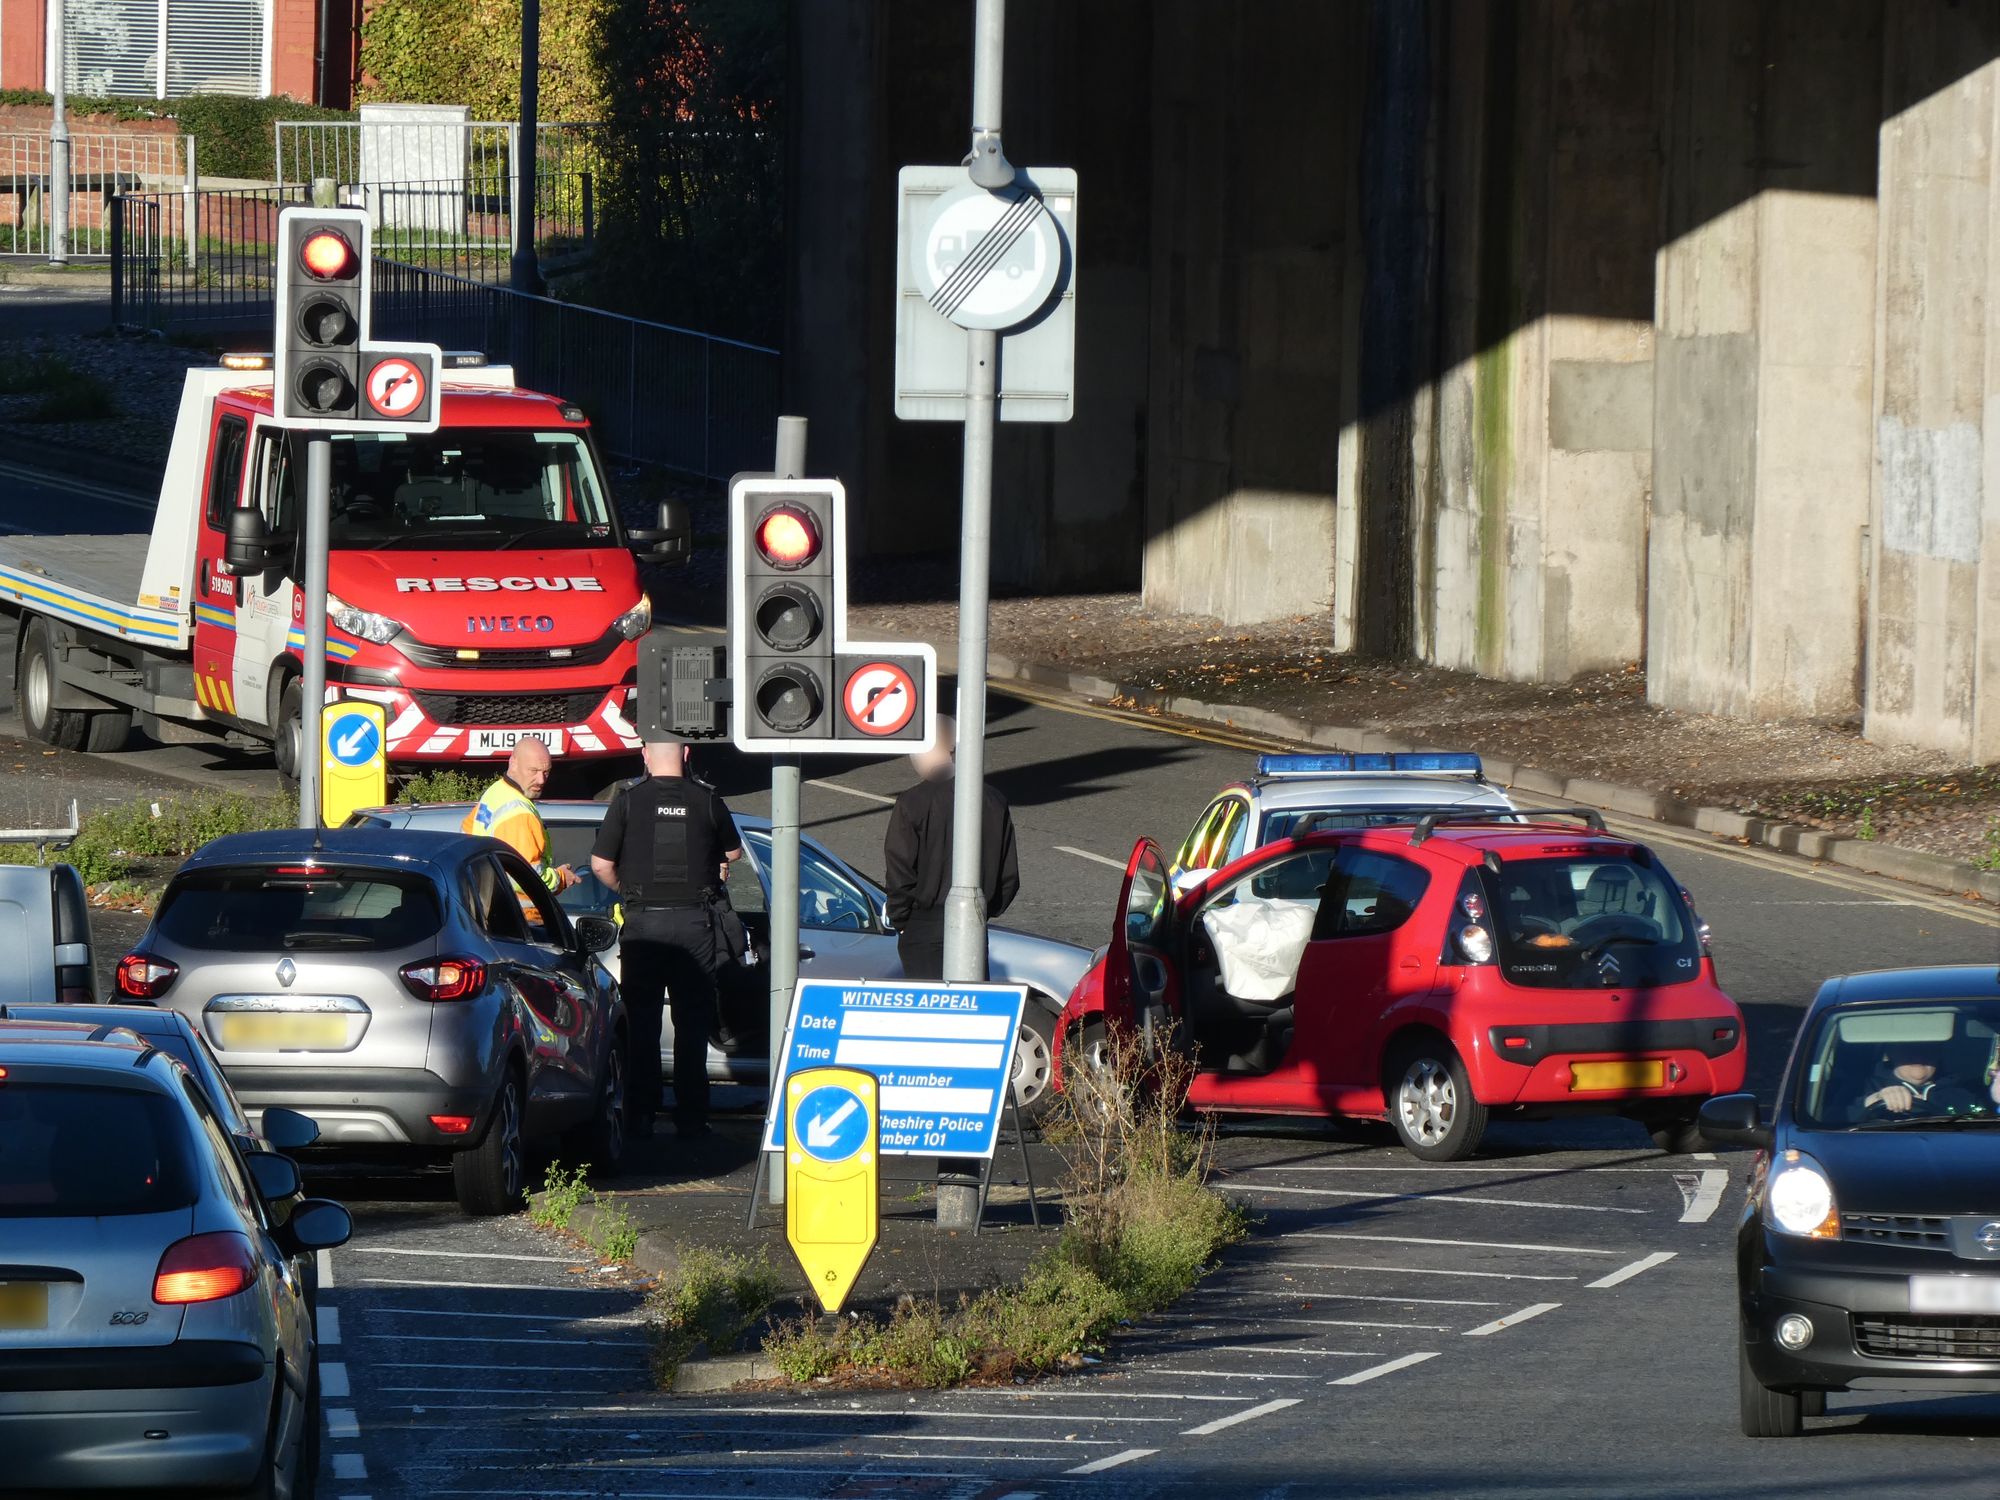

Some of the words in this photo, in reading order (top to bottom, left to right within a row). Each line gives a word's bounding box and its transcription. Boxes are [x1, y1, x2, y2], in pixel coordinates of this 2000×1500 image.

[395, 576, 604, 593] RESCUE
[466, 615, 555, 633] IVECO
[480, 732, 516, 748] ML19
[657, 807, 687, 816] POLICE
[842, 991, 914, 1007] WITNESS
[918, 994, 979, 1009] APPEAL
[801, 1014, 837, 1030] Date
[796, 1044, 831, 1059] Time
[898, 1073, 953, 1087] number
[879, 1115, 934, 1130] heshire
[938, 1117, 984, 1131] Police
[923, 1132, 947, 1147] 101
[109, 1311, 149, 1326] 206
